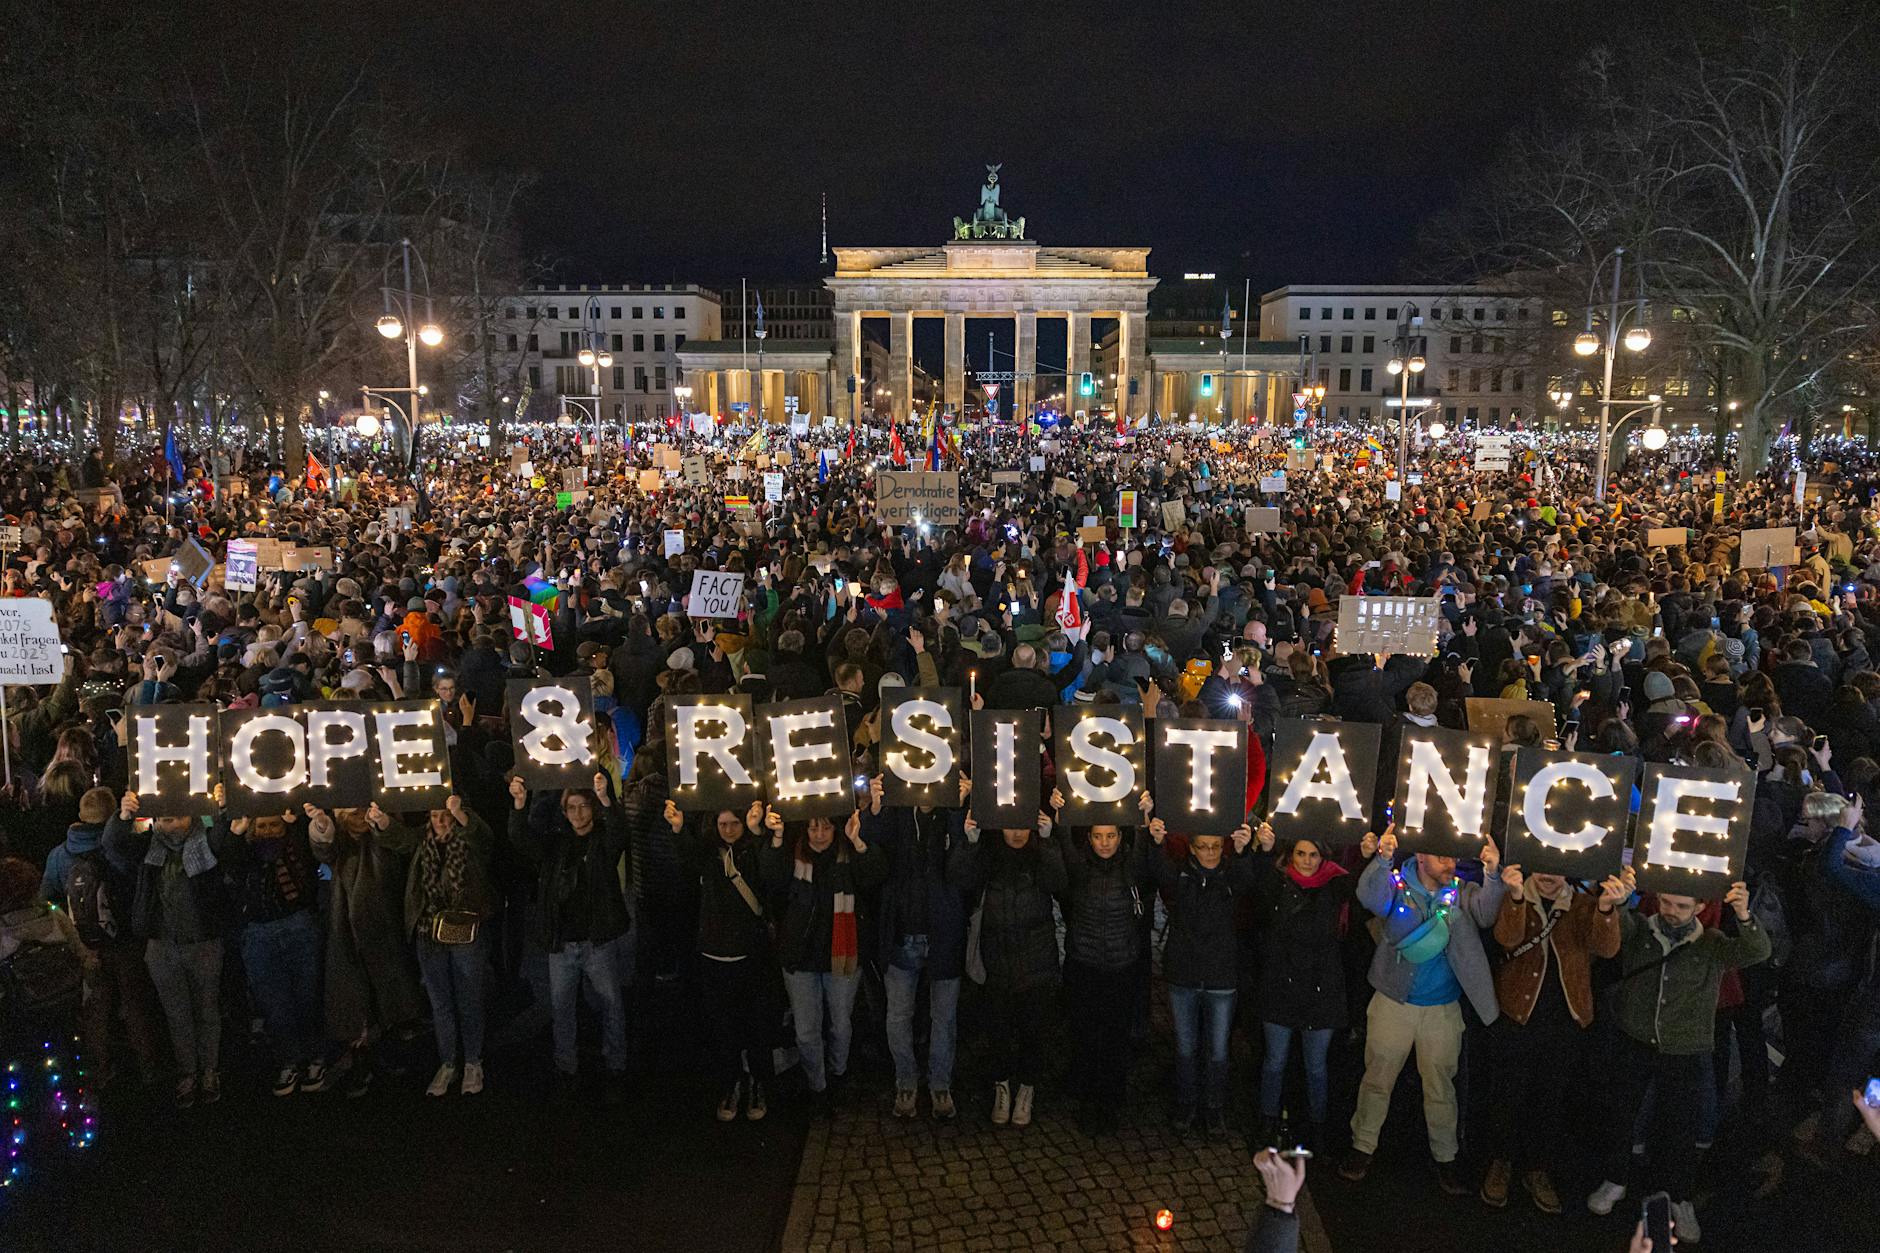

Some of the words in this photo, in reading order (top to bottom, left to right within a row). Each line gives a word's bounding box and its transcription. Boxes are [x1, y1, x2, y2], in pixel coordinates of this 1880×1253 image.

[879, 474, 955, 499] Demokratie
[880, 501, 958, 523] verteidigen
[698, 576, 742, 597] FACT
[704, 596, 739, 616] YOU!
[20, 633, 59, 649] fragen
[12, 647, 48, 661] 2025
[31, 664, 54, 675] hast
[136, 708, 445, 796] HOPE
[521, 685, 595, 766] &
[673, 699, 1739, 874] RESISTANCE
